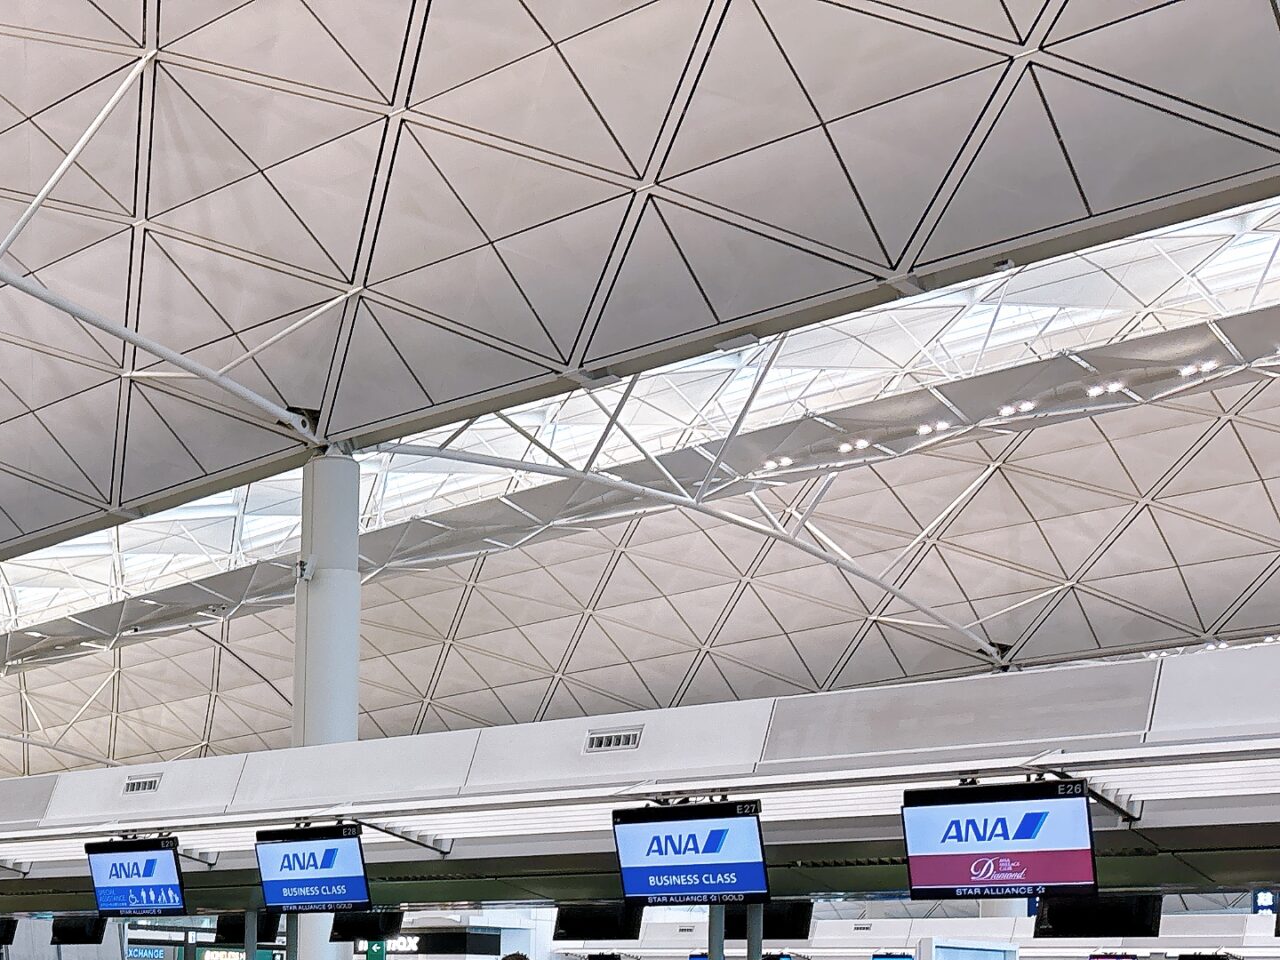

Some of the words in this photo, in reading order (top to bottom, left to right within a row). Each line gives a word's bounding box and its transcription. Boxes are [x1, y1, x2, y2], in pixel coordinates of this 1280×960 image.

[1057, 784, 1082, 795] E26
[736, 804, 756, 814] E27
[342, 828, 357, 836] E28
[940, 817, 1010, 843] ANA
[645, 833, 700, 857] ANA
[280, 852, 319, 872] ANA
[109, 862, 141, 880] ANA
[970, 857, 1026, 880] Diamond
[648, 874, 700, 887] BUSINESS
[701, 873, 737, 884] CLASS
[282, 886, 320, 897] BUSINESS
[321, 885, 347, 895] CLASS
[956, 888, 983, 896] STAR
[984, 886, 1033, 895] ALLIANCE
[648, 896, 669, 904] STAR
[669, 895, 708, 903] ALLIANCE
[722, 894, 744, 902] GOLD
[127, 948, 164, 959] XCHANGE
